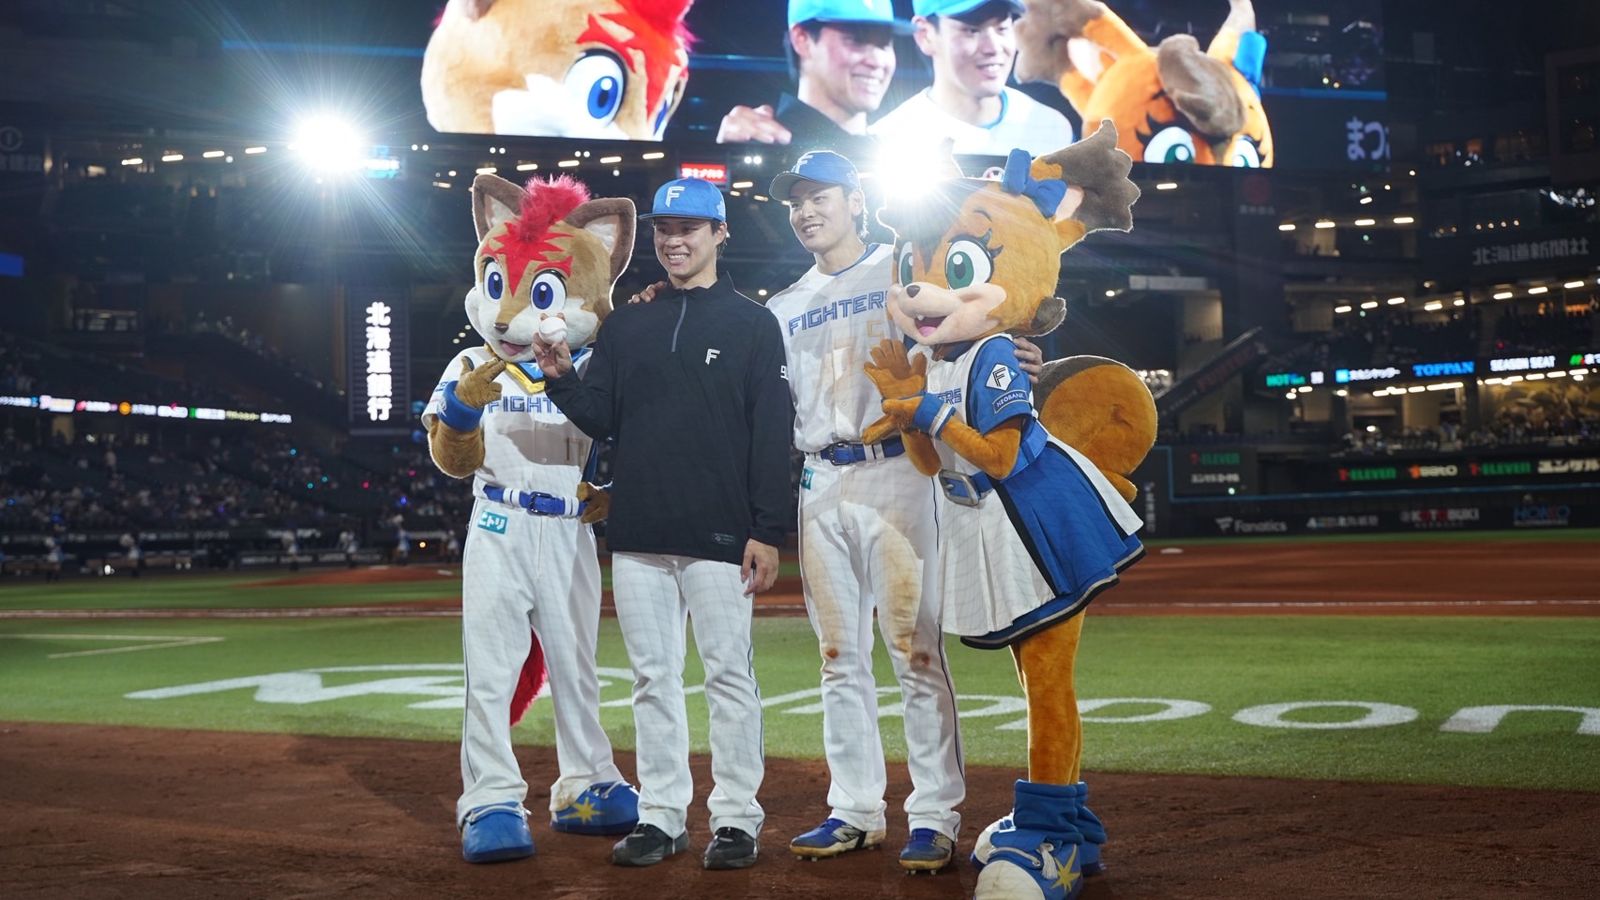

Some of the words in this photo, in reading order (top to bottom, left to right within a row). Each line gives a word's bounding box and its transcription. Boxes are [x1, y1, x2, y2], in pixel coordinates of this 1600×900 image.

[1346, 116, 1390, 161] まつ
[665, 185, 686, 208] F
[788, 290, 889, 337] FIGHTER
[704, 347, 721, 365] F
[993, 367, 1007, 387] F
[1413, 361, 1475, 377] TOPPAN
[488, 396, 563, 414] FIGHT
[996, 392, 1025, 408] NEOBANK
[479, 511, 506, 530] ニトリ
[1234, 518, 1288, 533] Fanatics
